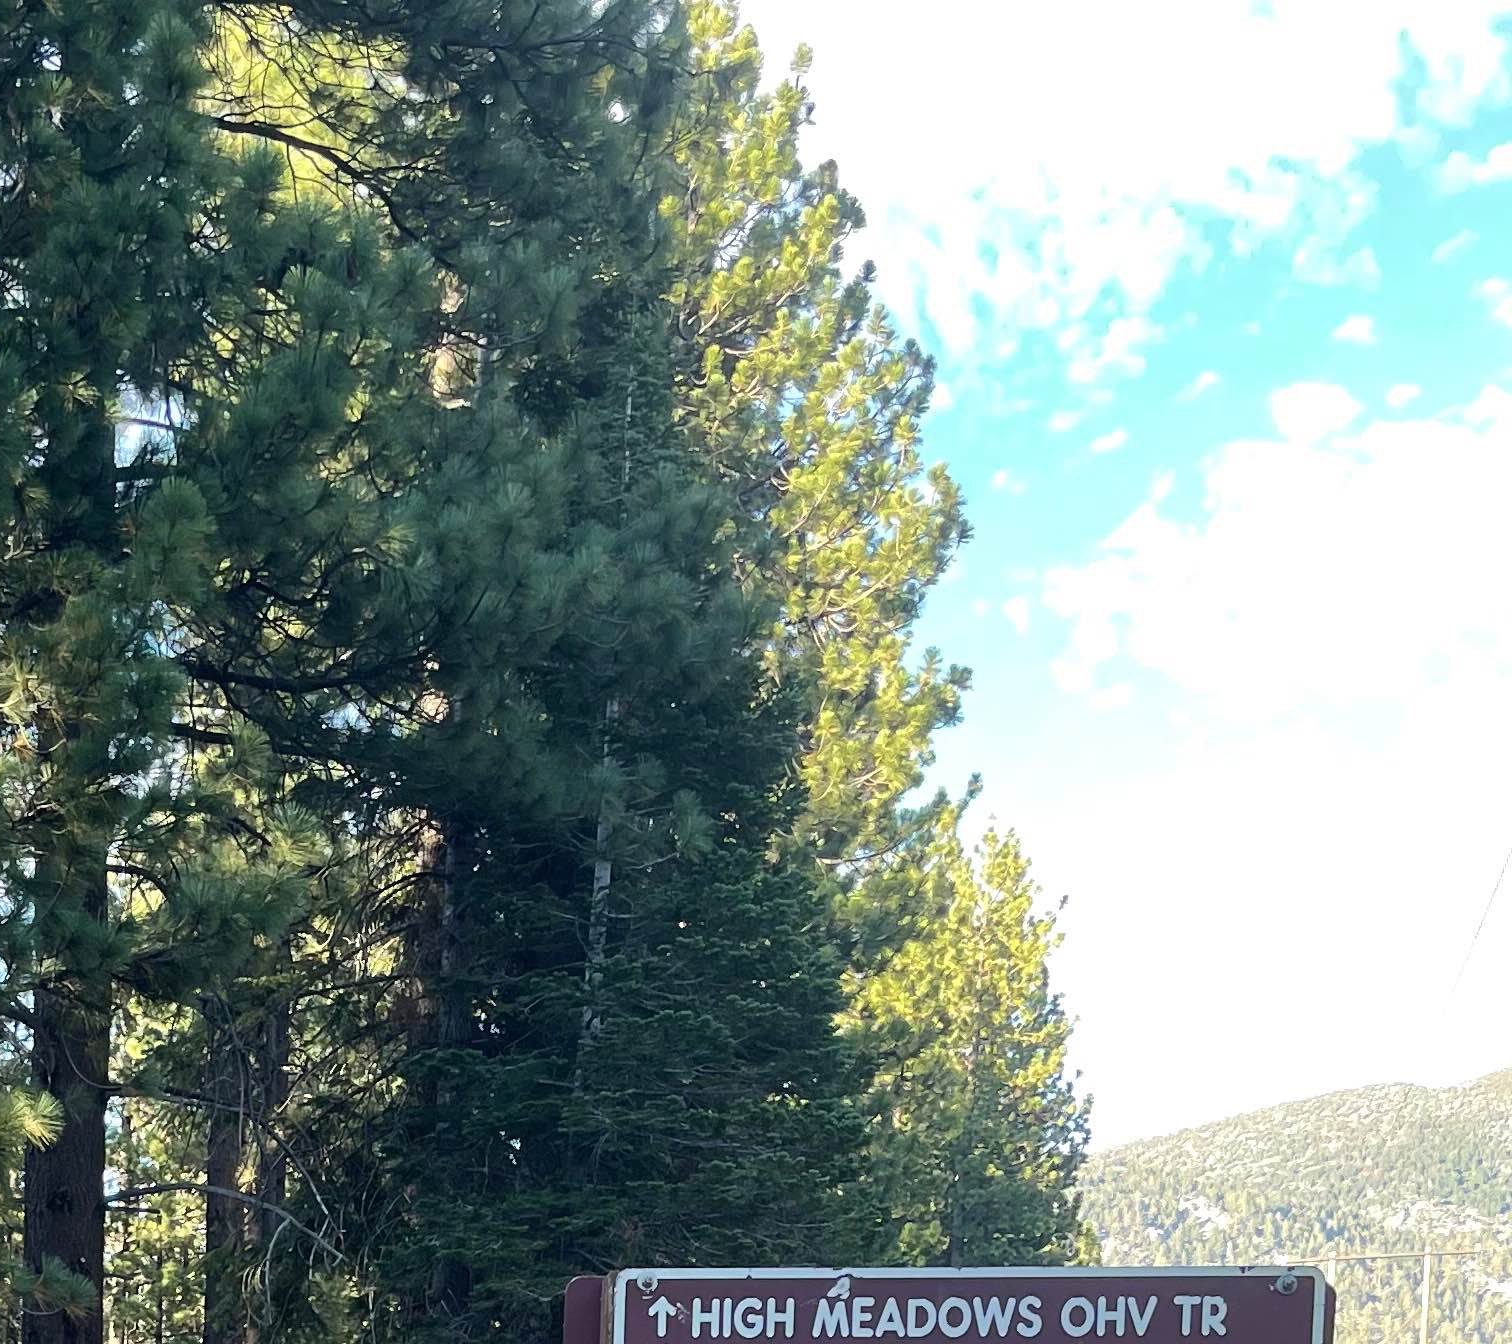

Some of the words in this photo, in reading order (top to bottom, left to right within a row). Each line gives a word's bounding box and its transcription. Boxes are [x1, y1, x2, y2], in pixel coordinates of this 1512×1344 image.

[691, 1297, 795, 1338] HIGH
[811, 1296, 1042, 1338] MEADOWS
[1060, 1295, 1158, 1337] OHV
[1173, 1295, 1228, 1336] TR
